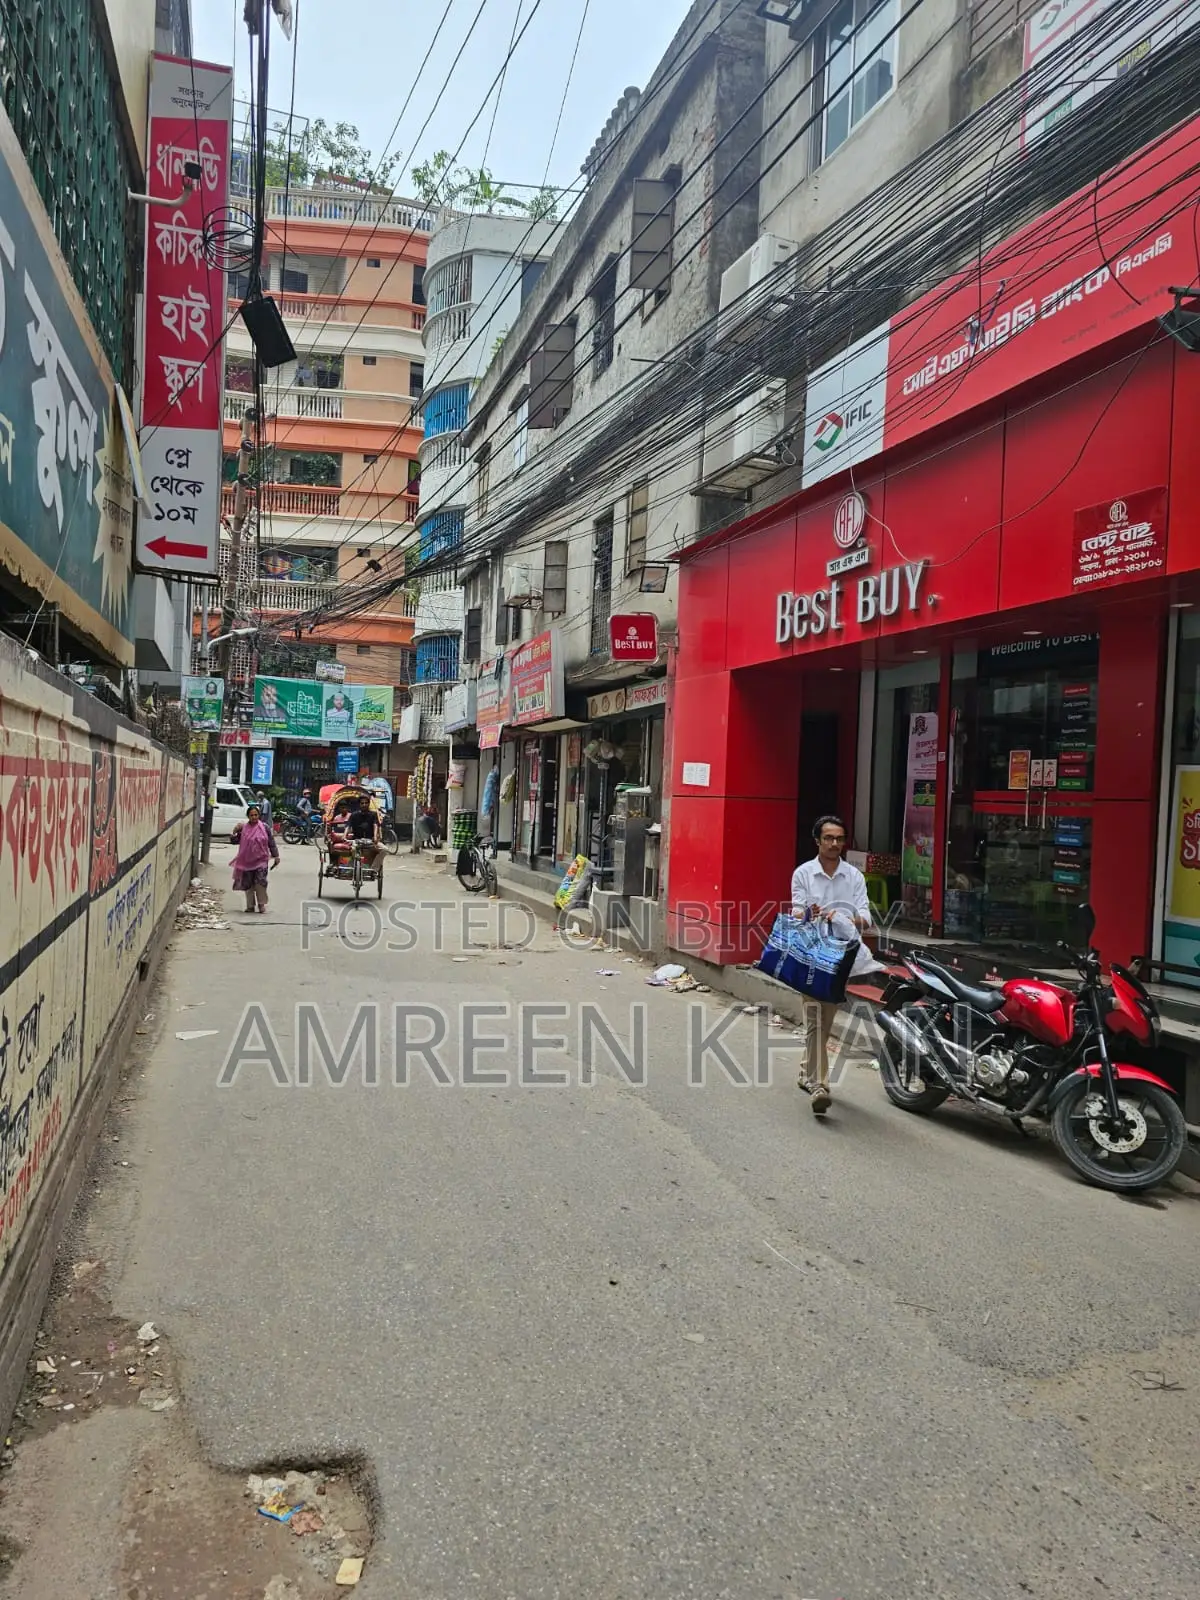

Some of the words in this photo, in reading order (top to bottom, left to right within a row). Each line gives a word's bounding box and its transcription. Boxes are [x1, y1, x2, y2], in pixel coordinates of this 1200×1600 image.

[170, 96, 211, 112] অনুমোদিত
[178, 86, 204, 99] সরকার
[158, 285, 210, 347] হাই
[159, 355, 207, 414] স্কুল
[24, 268, 97, 535] স্কুল
[845, 400, 872, 429] IFIC
[166, 447, 192, 469] প্লে
[151, 475, 204, 497] থেকে
[154, 502, 198, 525] ১০ম
[1081, 529, 1118, 552] বেস্ট
[1119, 522, 1155, 542] বাই
[829, 559, 841, 573] আর
[842, 554, 853, 569] এফ
[855, 549, 866, 563] এল
[776, 580, 843, 643] Best
[615, 639, 634, 649] Best
[637, 641, 653, 649] BUY
